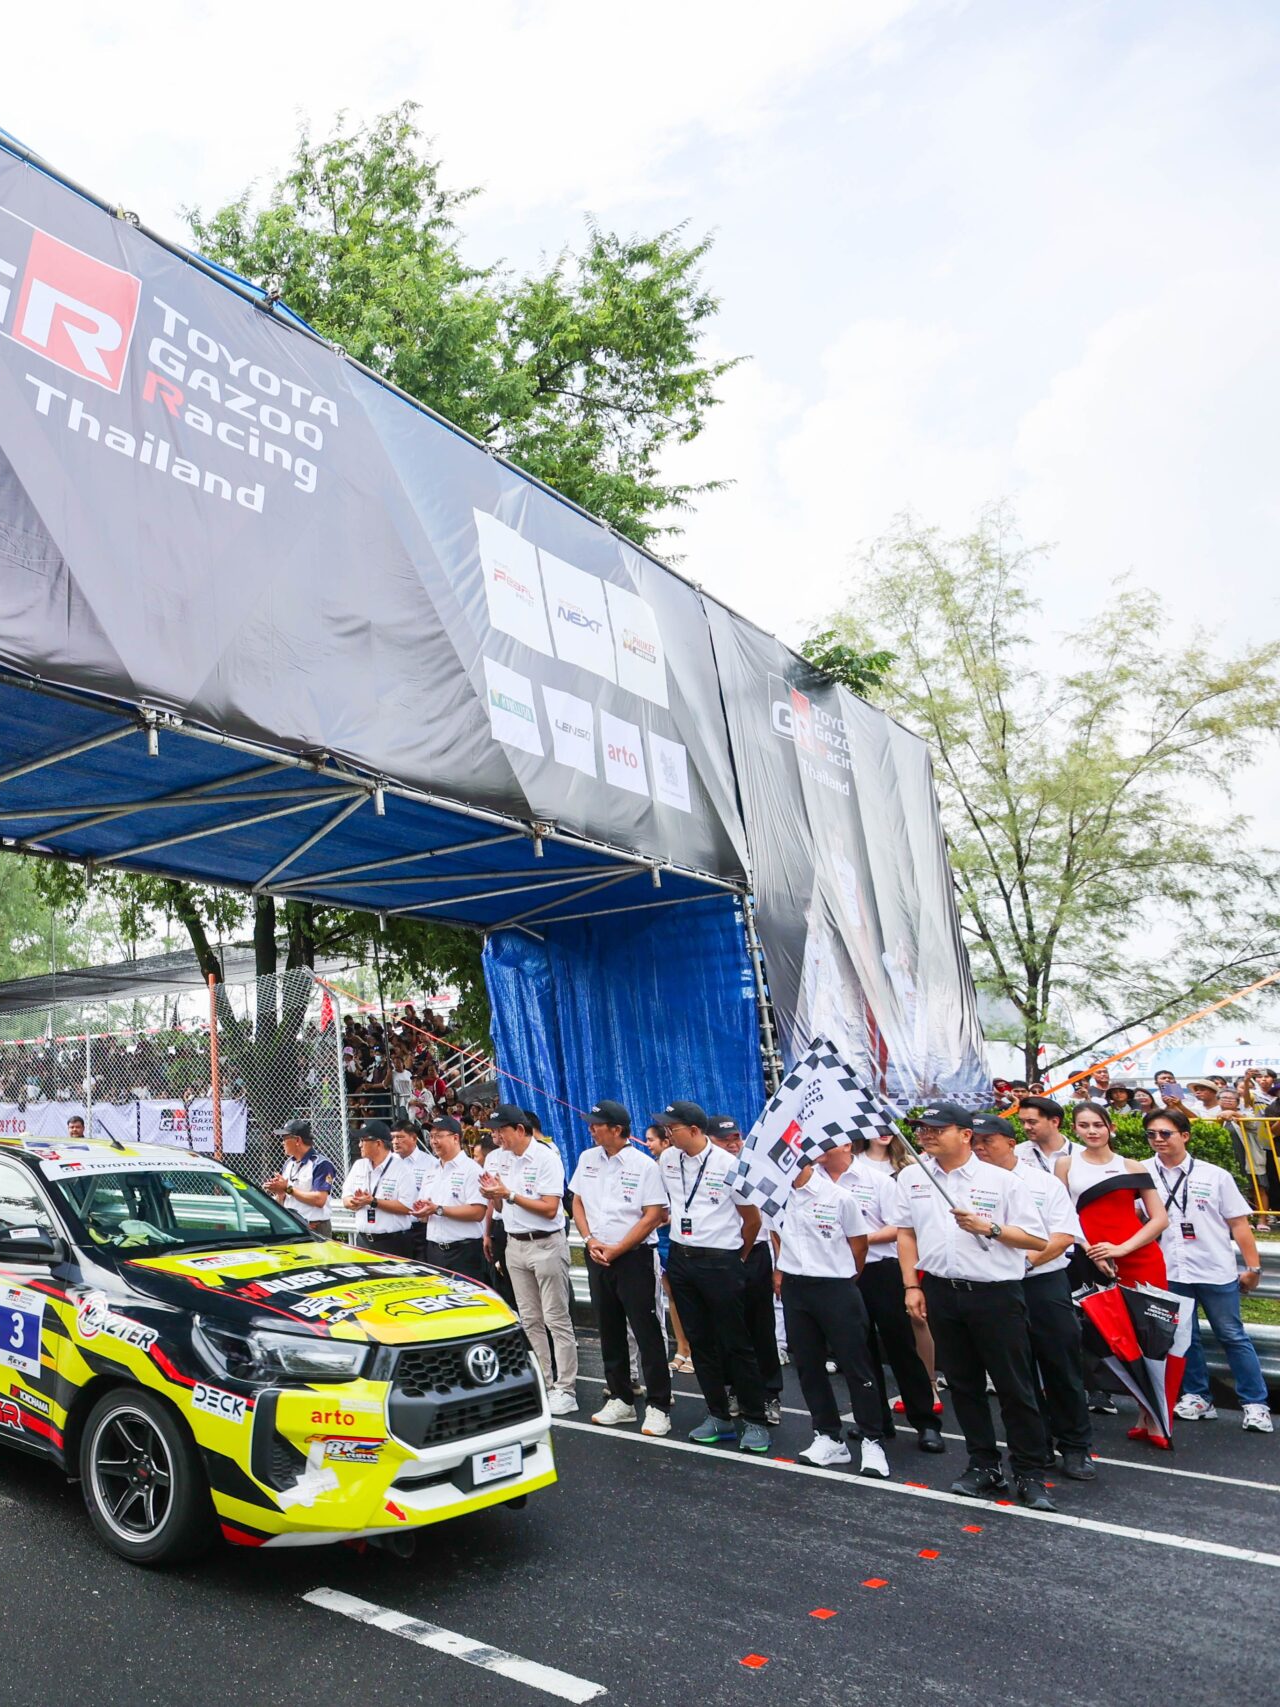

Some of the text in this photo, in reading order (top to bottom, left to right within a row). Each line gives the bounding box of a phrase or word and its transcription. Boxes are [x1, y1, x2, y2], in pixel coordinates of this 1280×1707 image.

[153, 296, 339, 428] TOYOTA
[148, 336, 324, 452] GAZOO
[24, 372, 265, 514] Thailand
[142, 369, 318, 494] Racing
[557, 606, 603, 635] NEXT
[555, 718, 591, 742] LENSO
[607, 743, 638, 769] arto
[801, 757, 850, 796] Thailand
[1230, 1058, 1254, 1068] ptt
[221, 1172, 249, 1191] 3
[404, 1295, 489, 1314] BKC
[9, 1311, 25, 1349] 3
[194, 1384, 245, 1418] DECK
[311, 1410, 356, 1426] arto
[326, 1441, 361, 1456] BK
